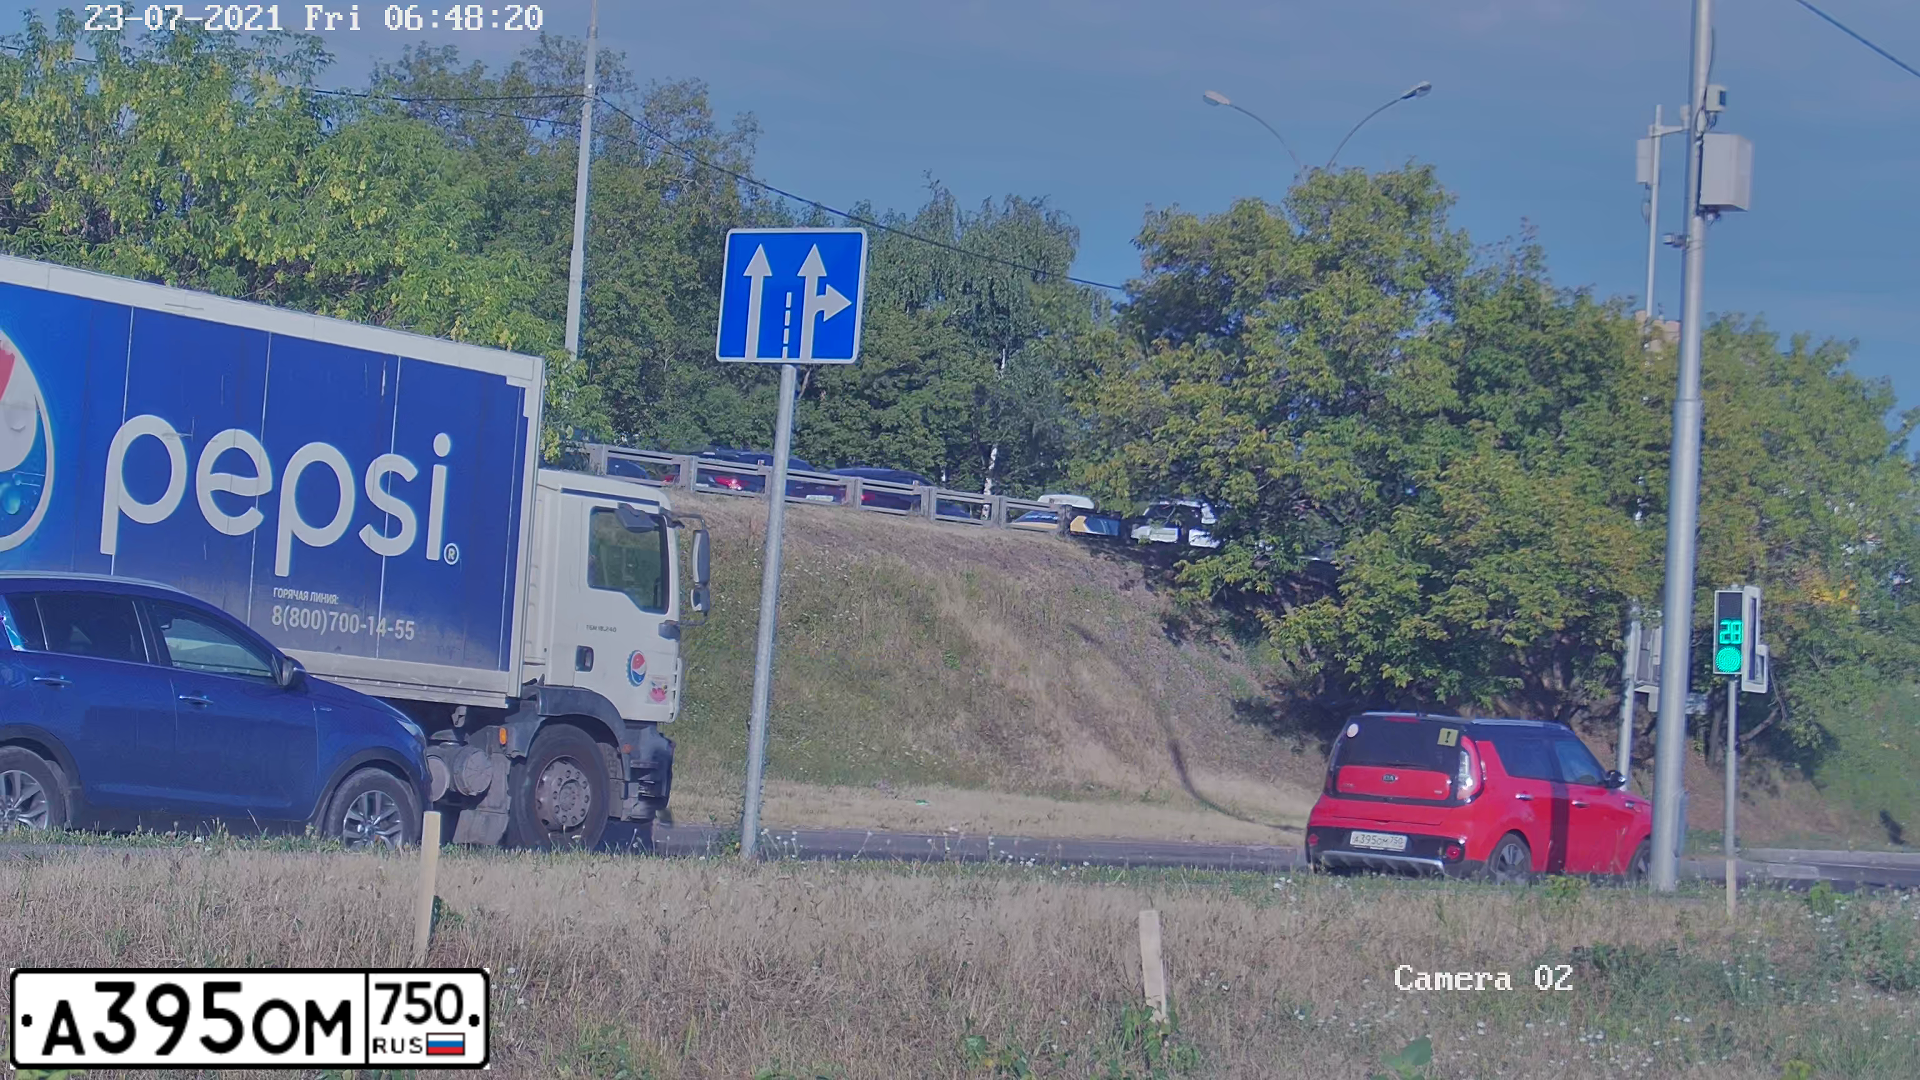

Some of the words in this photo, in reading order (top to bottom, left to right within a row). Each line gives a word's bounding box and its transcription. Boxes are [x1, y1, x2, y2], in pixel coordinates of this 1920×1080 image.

[100, 414, 451, 577] pepsi
[273, 587, 308, 602] ГОРЯЧАЯ
[310, 591, 339, 605] ЛИНИЯ:
[271, 604, 415, 641] 8(800)700-14-55
